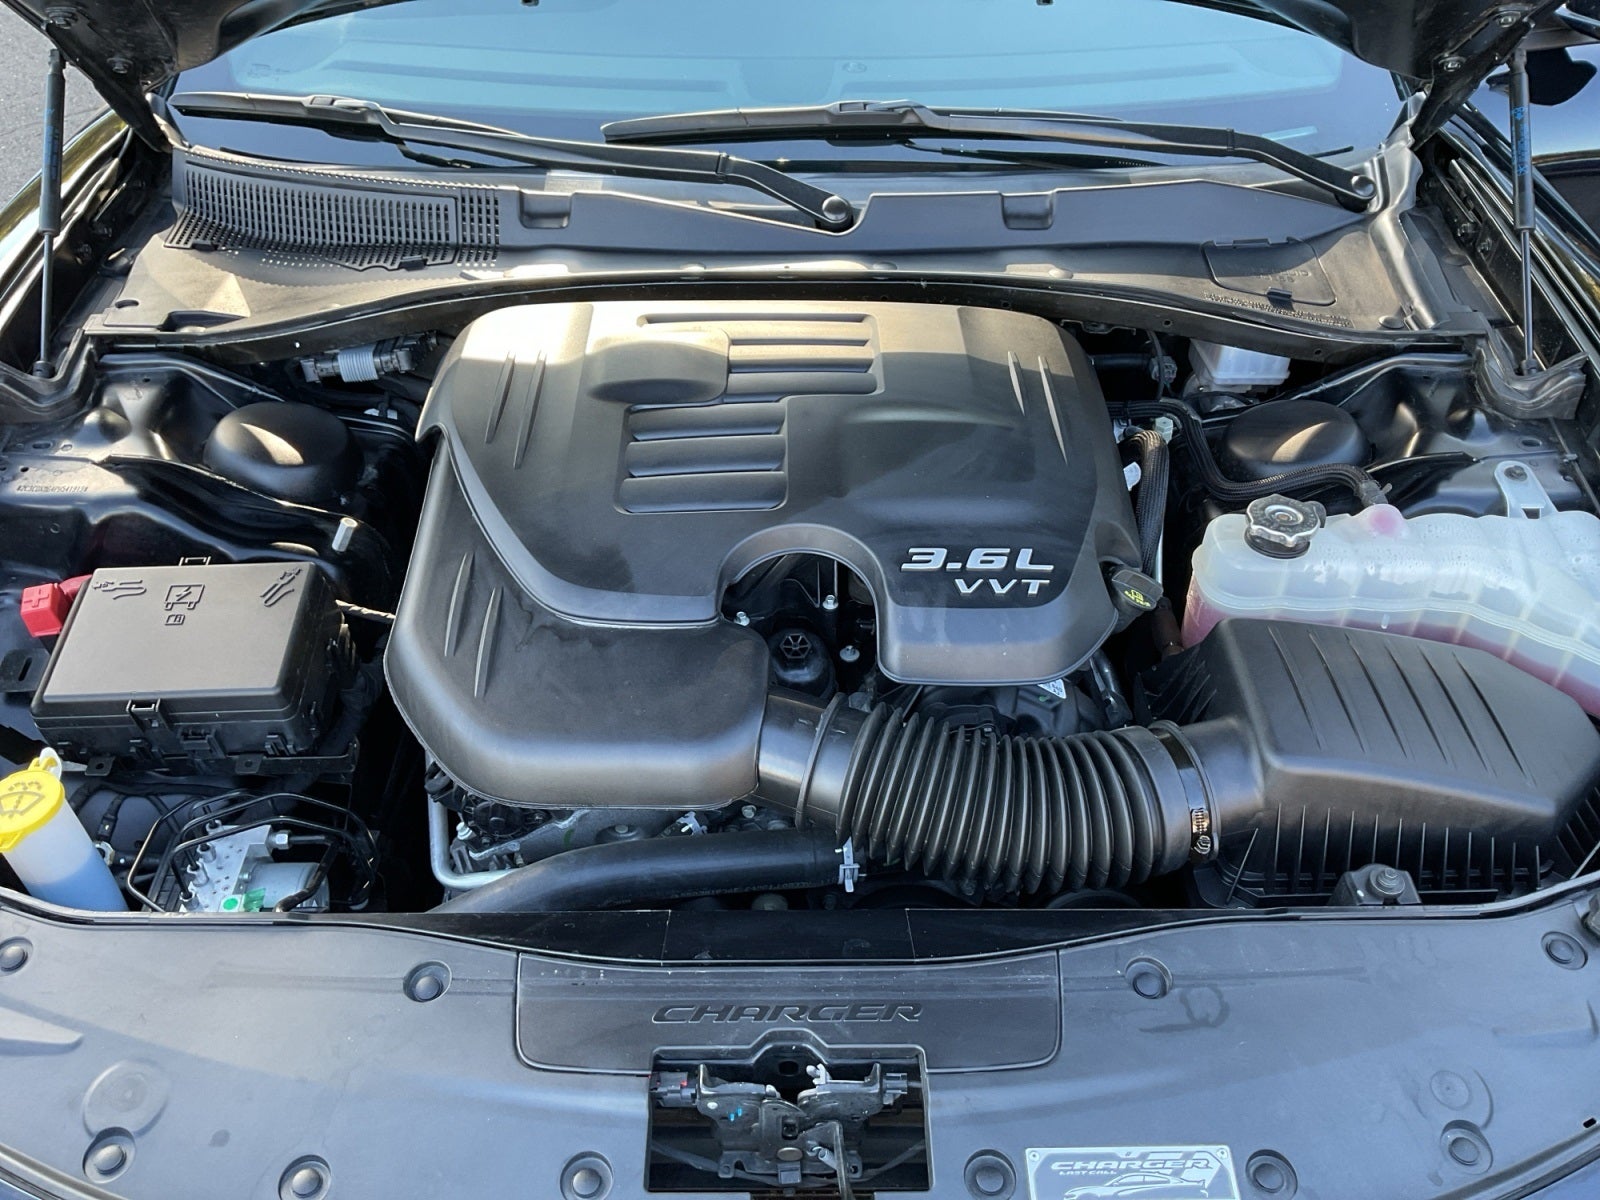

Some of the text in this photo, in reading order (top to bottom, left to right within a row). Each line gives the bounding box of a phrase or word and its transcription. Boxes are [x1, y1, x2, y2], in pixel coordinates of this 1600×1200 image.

[901, 547, 1055, 572] 3.6L
[954, 578, 1050, 597] VVT
[652, 1003, 922, 1024] CHARGER
[1051, 1160, 1212, 1170] CHARGER
